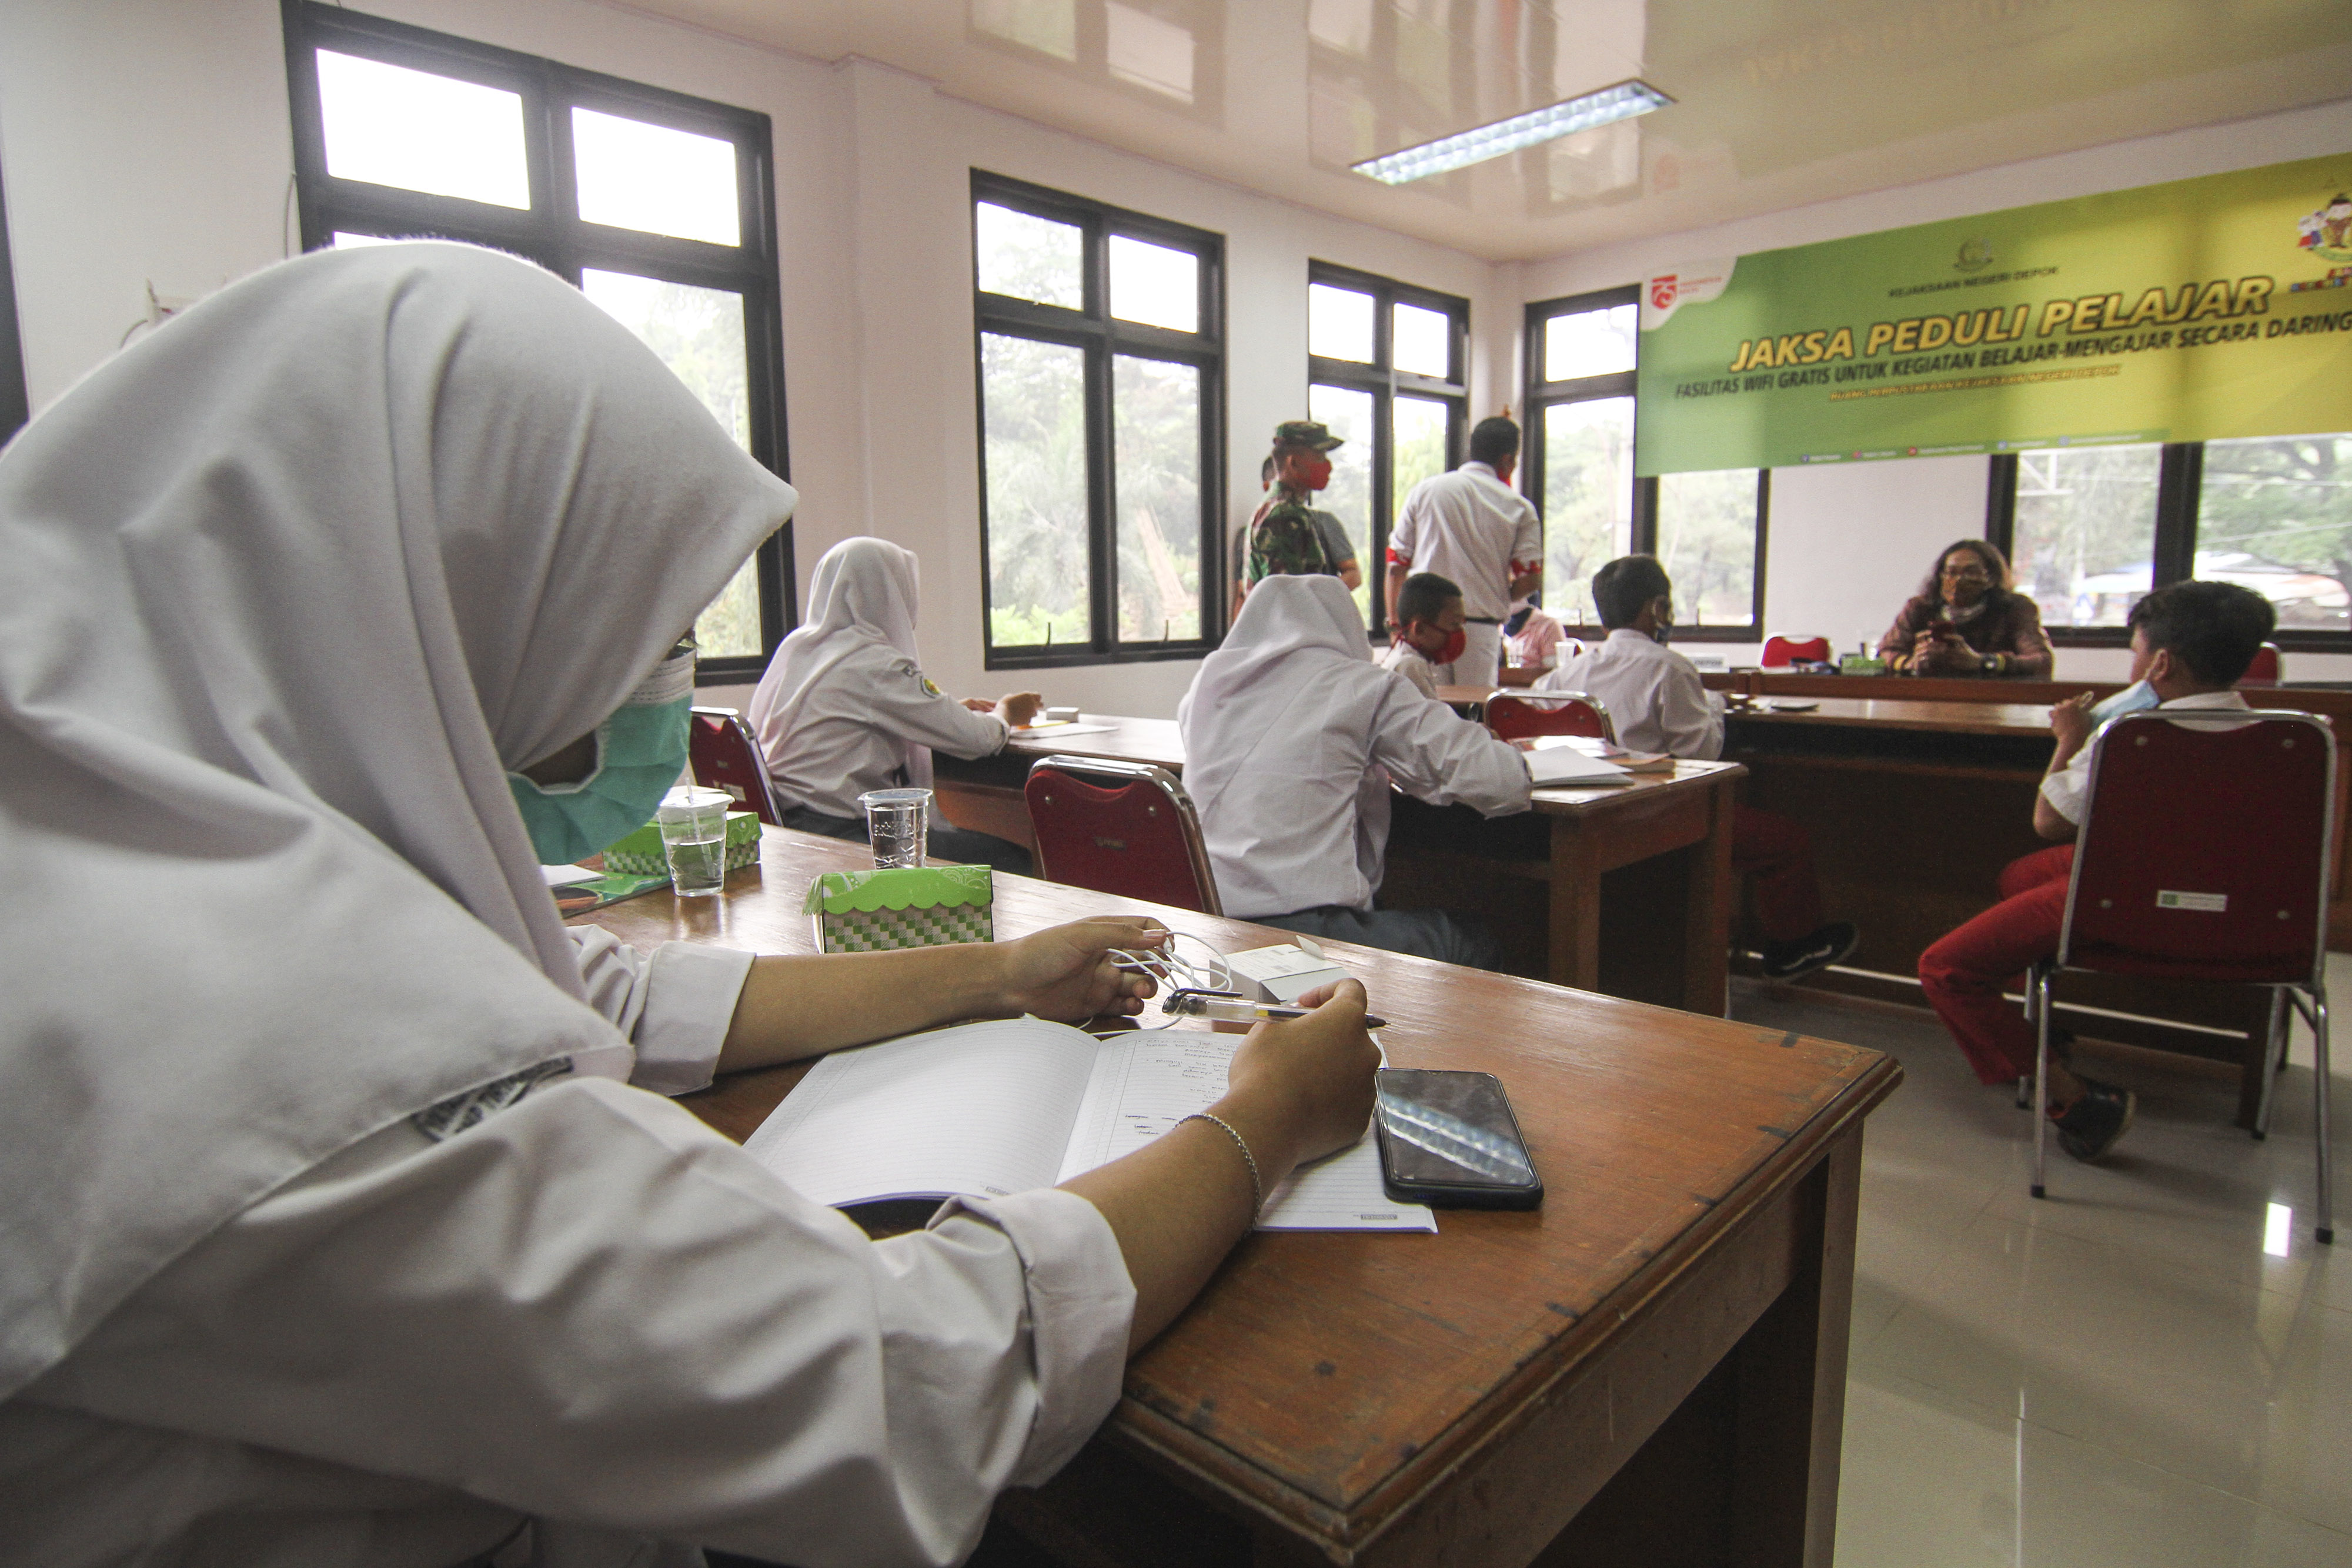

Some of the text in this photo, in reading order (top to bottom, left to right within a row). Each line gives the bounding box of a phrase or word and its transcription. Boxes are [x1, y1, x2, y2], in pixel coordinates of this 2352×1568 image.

[1676, 377, 1739, 398] FASILITAS
[1744, 375, 1775, 391] WIFI
[1778, 367, 1830, 389] GRATIS
[1834, 360, 1888, 382] UNTUK
[1892, 352, 1974, 376] KEGIATAN
[2178, 321, 2259, 348] SECARA
[2266, 310, 2352, 339] DARING
[1729, 327, 1854, 373] JAKSA
[1865, 303, 2030, 357] PEDULI
[2036, 275, 2274, 337] PELAJAR
